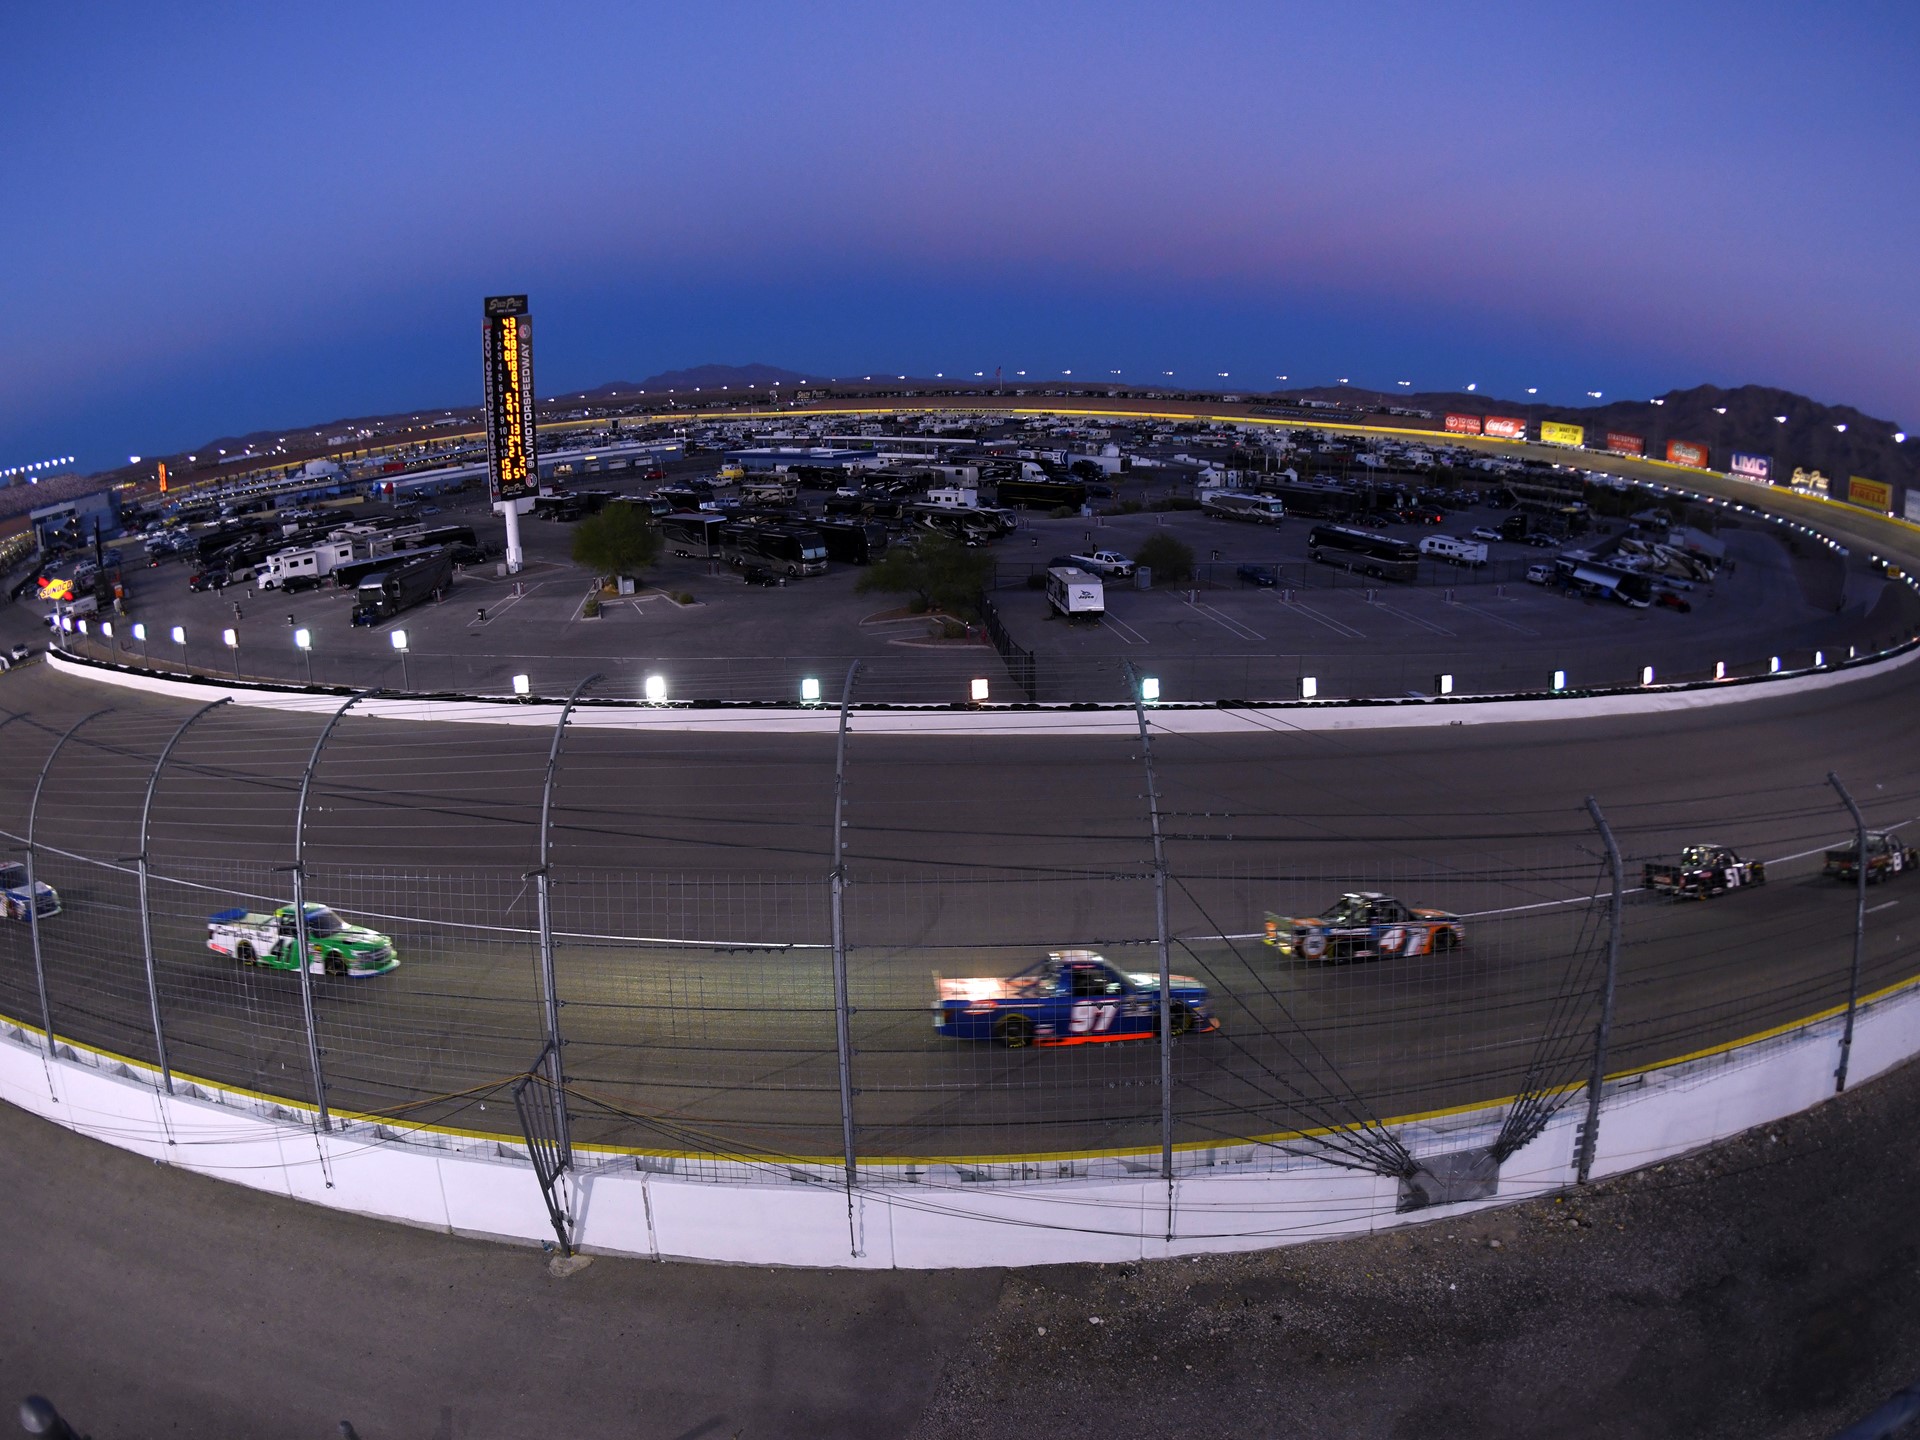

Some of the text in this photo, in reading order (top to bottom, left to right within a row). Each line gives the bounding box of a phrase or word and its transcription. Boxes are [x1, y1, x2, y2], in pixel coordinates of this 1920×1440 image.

[502, 317, 516, 328] 43
[503, 329, 517, 339] 52
[504, 340, 517, 350] 98
[504, 350, 517, 361] 88
[508, 361, 518, 371] 18
[511, 371, 518, 381] 8
[511, 382, 519, 391] 4
[506, 403, 519, 413] 97
[1458, 417, 1480, 426] TOYOTA
[499, 424, 520, 435] 10 13
[500, 435, 521, 446] 11 24
[500, 449, 508, 457] 12
[501, 456, 526, 469] 15 2
[502, 467, 526, 480] 16 54
[42, 580, 72, 597] SUNOCO
[1725, 868, 1740, 888] 51
[1070, 999, 1120, 1033] 97
